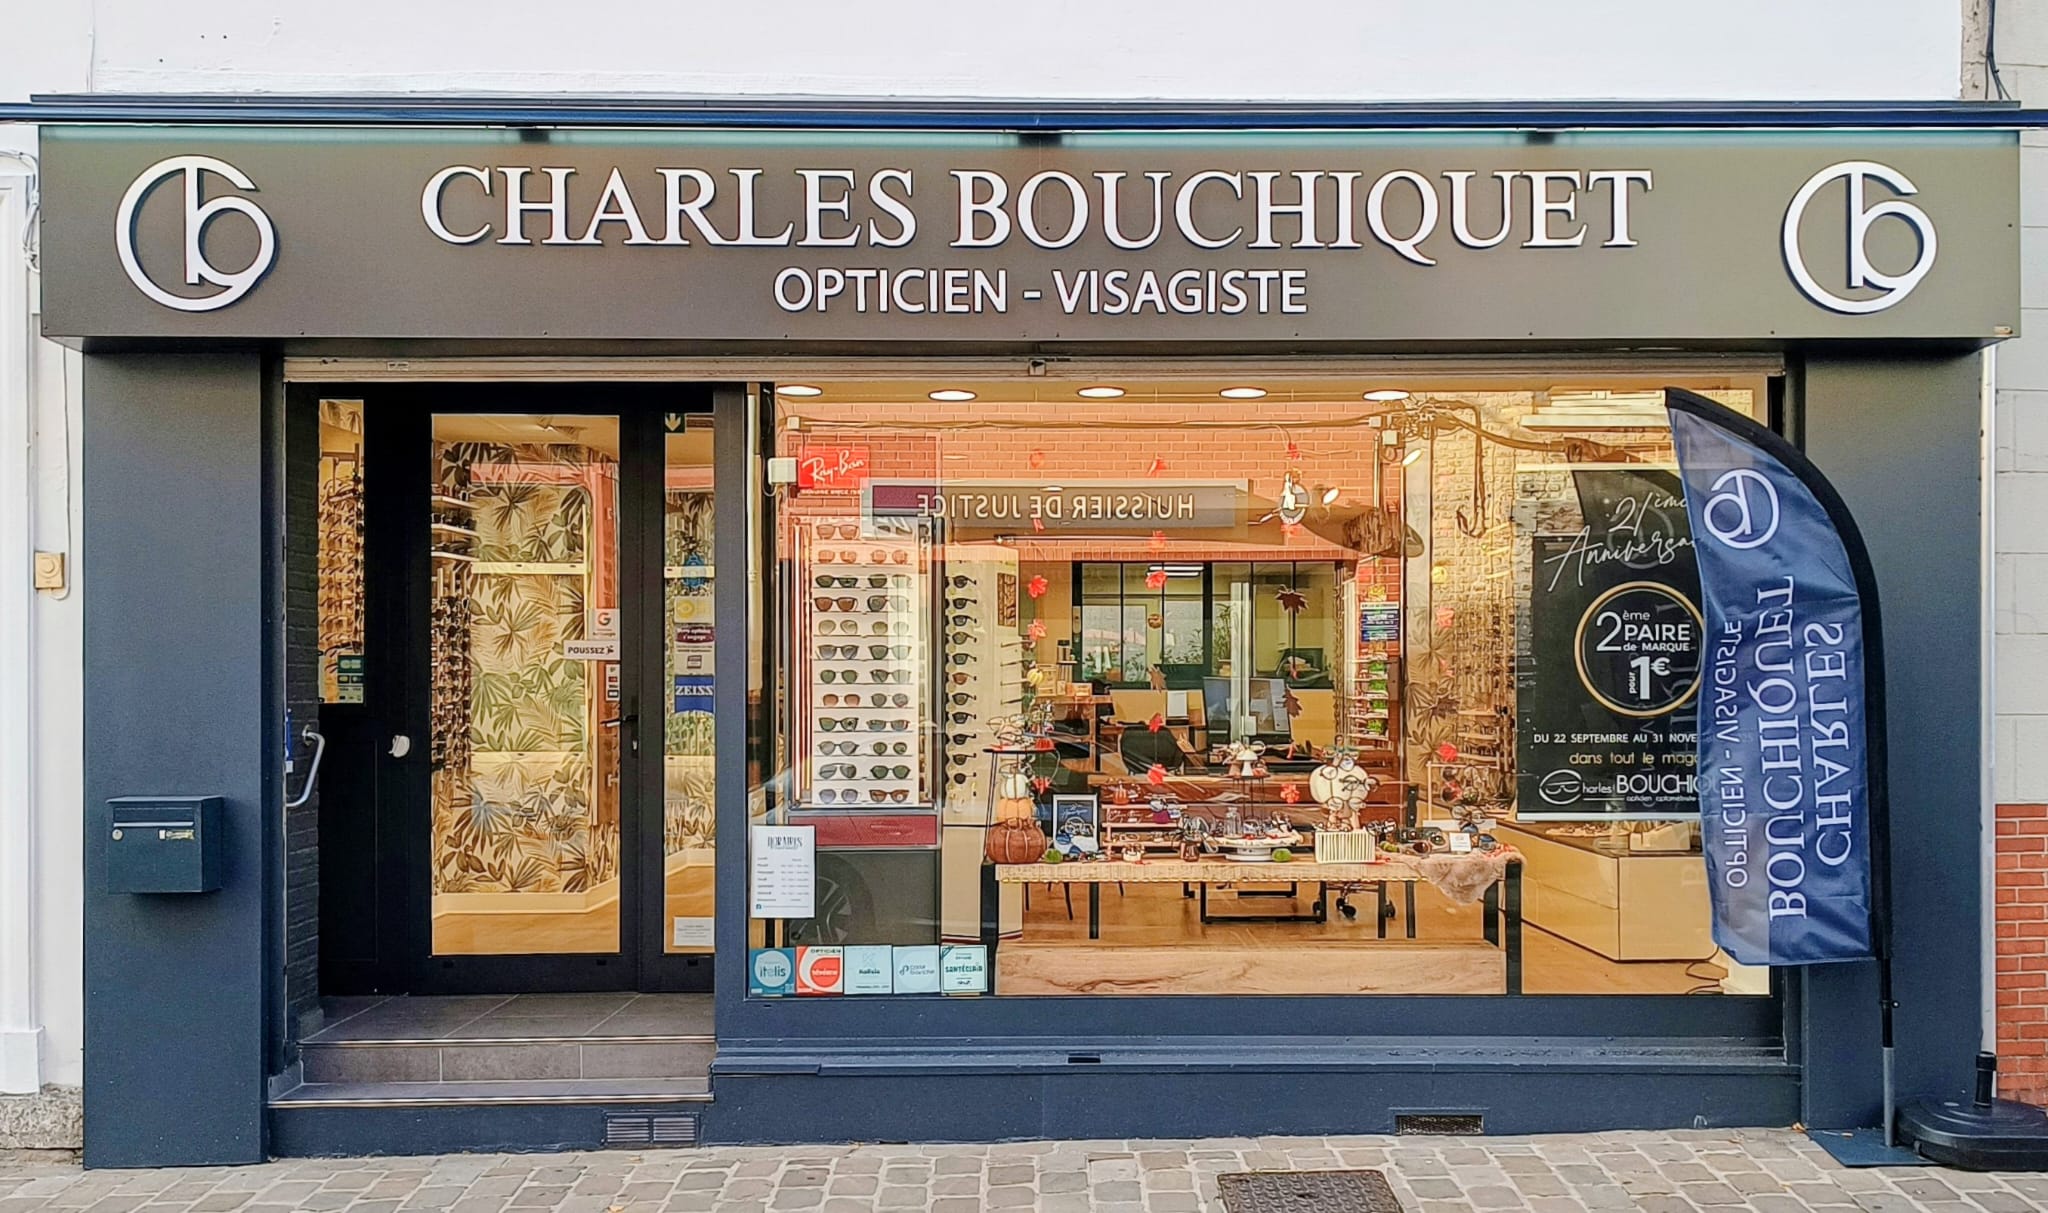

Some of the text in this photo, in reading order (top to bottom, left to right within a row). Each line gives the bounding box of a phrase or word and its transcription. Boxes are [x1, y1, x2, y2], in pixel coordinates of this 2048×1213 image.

[421, 165, 1655, 266] CHARLES BOUCHIQUET
[773, 266, 1008, 314] OPTICIEN
[1052, 269, 1308, 315] VISAGISTE
[802, 450, 864, 482] Ray-Ban
[1544, 525, 1695, 592] Anniversa
[1624, 623, 1691, 641] PAIRE
[568, 646, 605, 654] POUSSEZ
[1623, 642, 1690, 653] de MARQUE
[675, 685, 714, 696] ZEISS
[1629, 671, 1638, 695] pour
[1533, 733, 1697, 744] DU 22 SEPTEMBRE AU 31 NOVE
[1569, 752, 1602, 765] dans
[1610, 752, 1635, 765] tout
[1642, 752, 1655, 765] le
